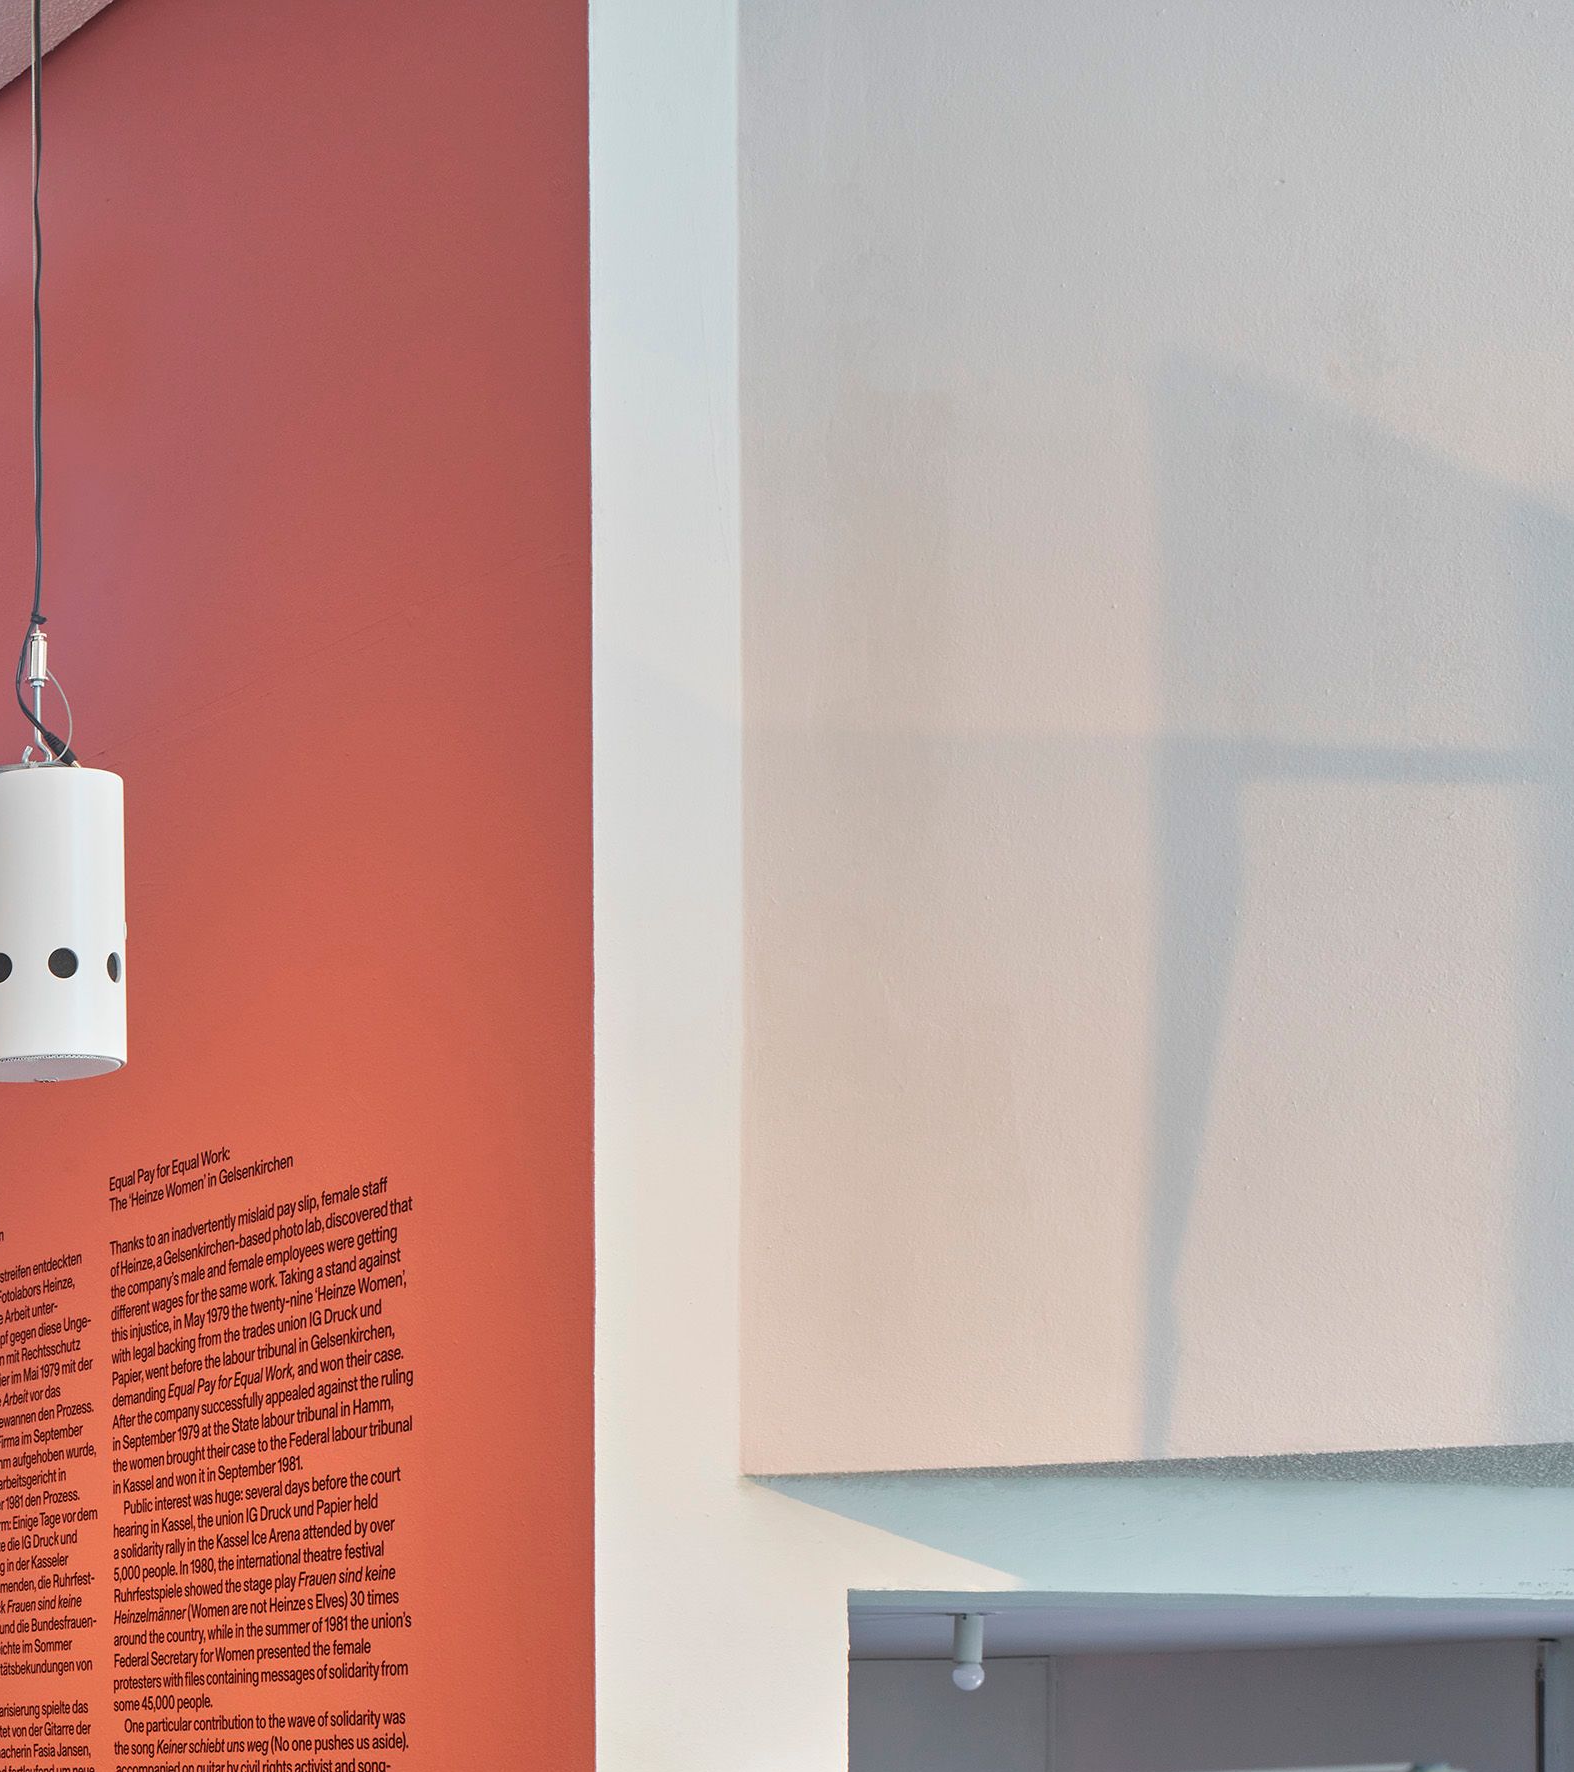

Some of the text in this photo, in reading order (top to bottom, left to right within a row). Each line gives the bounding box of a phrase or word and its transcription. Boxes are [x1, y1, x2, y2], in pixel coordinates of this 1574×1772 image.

[107, 1195, 128, 1213] The
[206, 1171, 217, 1188] in
[217, 1154, 294, 1185] Gelsenkirchen
[108, 1145, 231, 1193] Equal Pay for Equal Work:
[108, 1174, 388, 1256] Thanks to an inadvertently mislaid pay slip, female staff
[41, 1275, 76, 1294] Heinze,
[109, 1246, 402, 1321] different wages for the same work. Taking a stand against
[111, 1367, 414, 1430] After the company successfully appealed against the ruling
[5, 1557, 15, 1573] in
[14, 1555, 31, 1572] der
[29, 1551, 69, 1570] Kasseler
[112, 1563, 397, 1604] Ruhrfestspiele showed the stage play Frauen sind keine
[112, 1691, 213, 1714] some 45,000 people.
